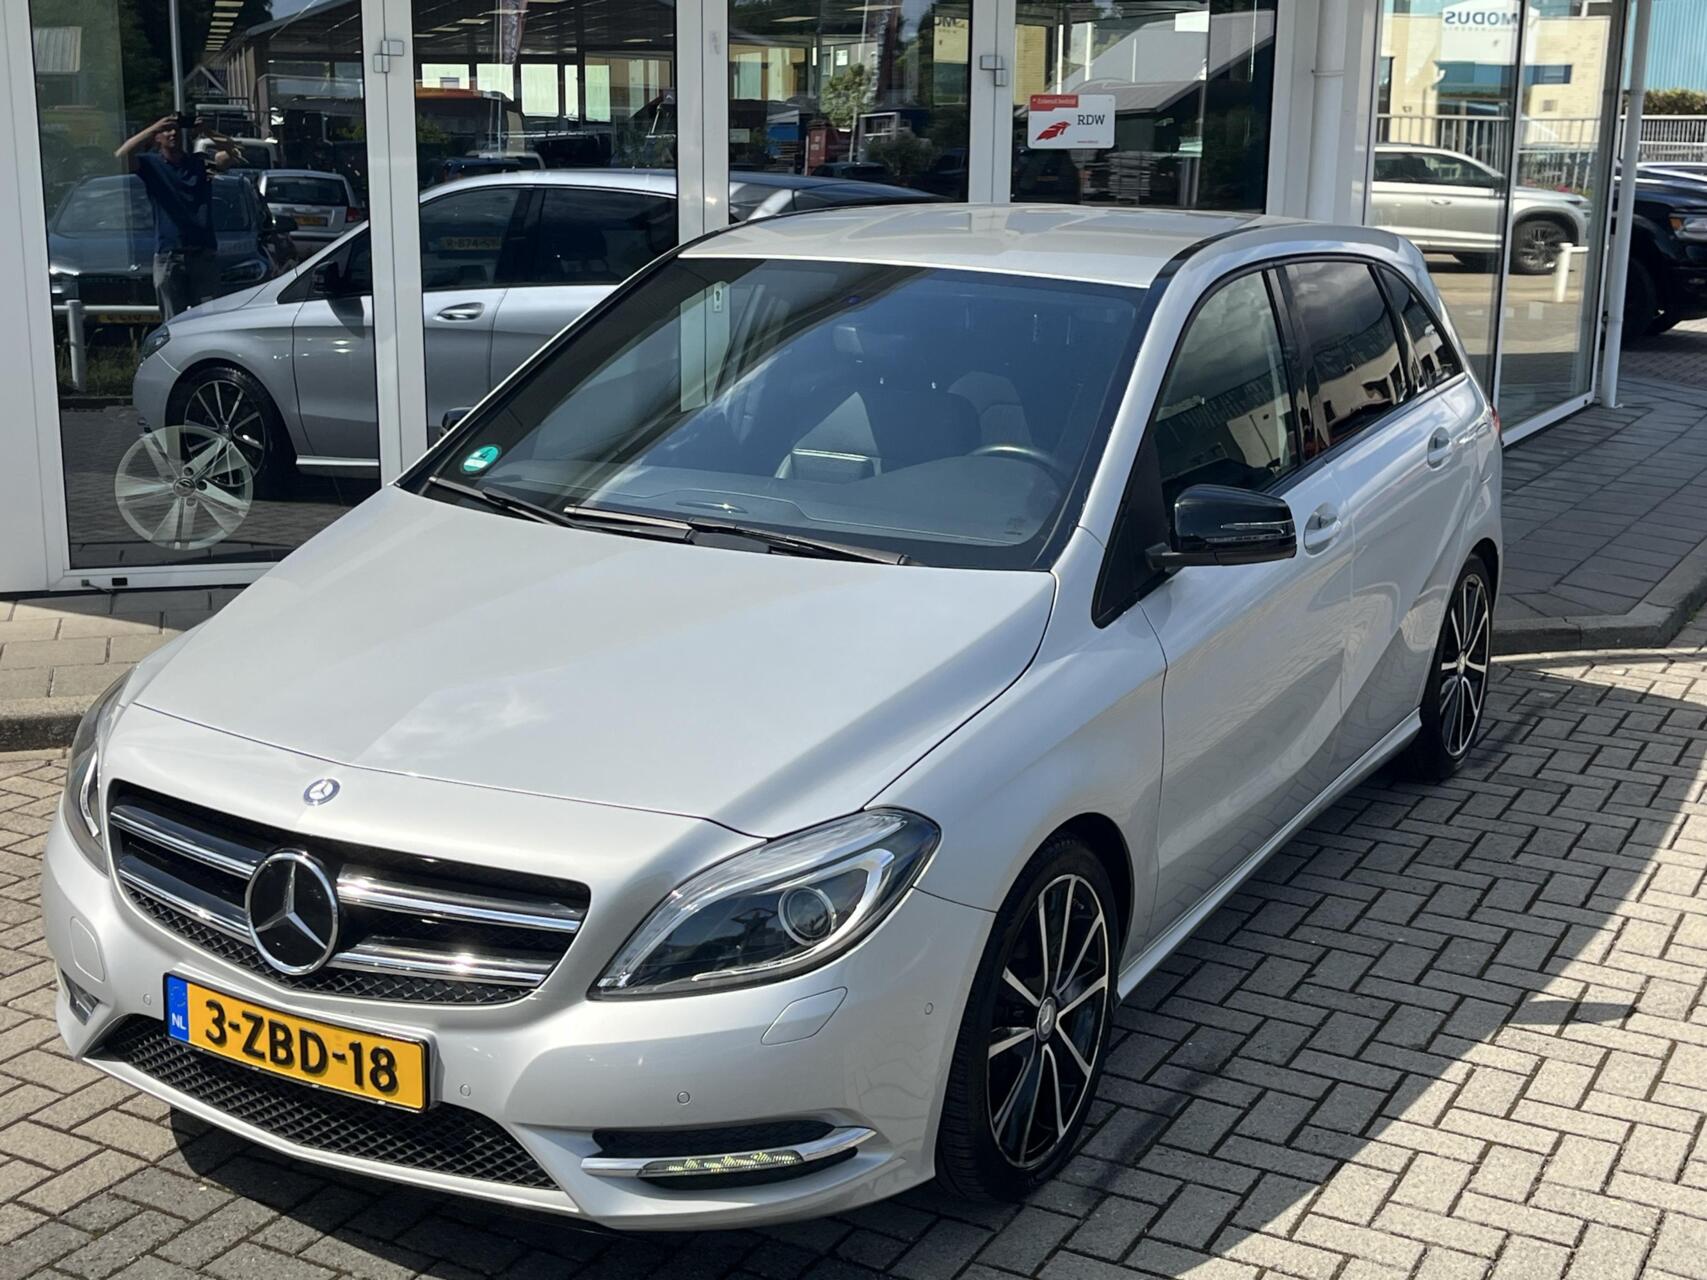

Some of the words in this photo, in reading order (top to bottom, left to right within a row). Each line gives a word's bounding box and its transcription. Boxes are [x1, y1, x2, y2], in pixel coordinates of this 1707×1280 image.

[1077, 114, 1105, 126] RDW
[171, 1012, 187, 1031] NL
[205, 999, 399, 1095] 3-ZBD-18
